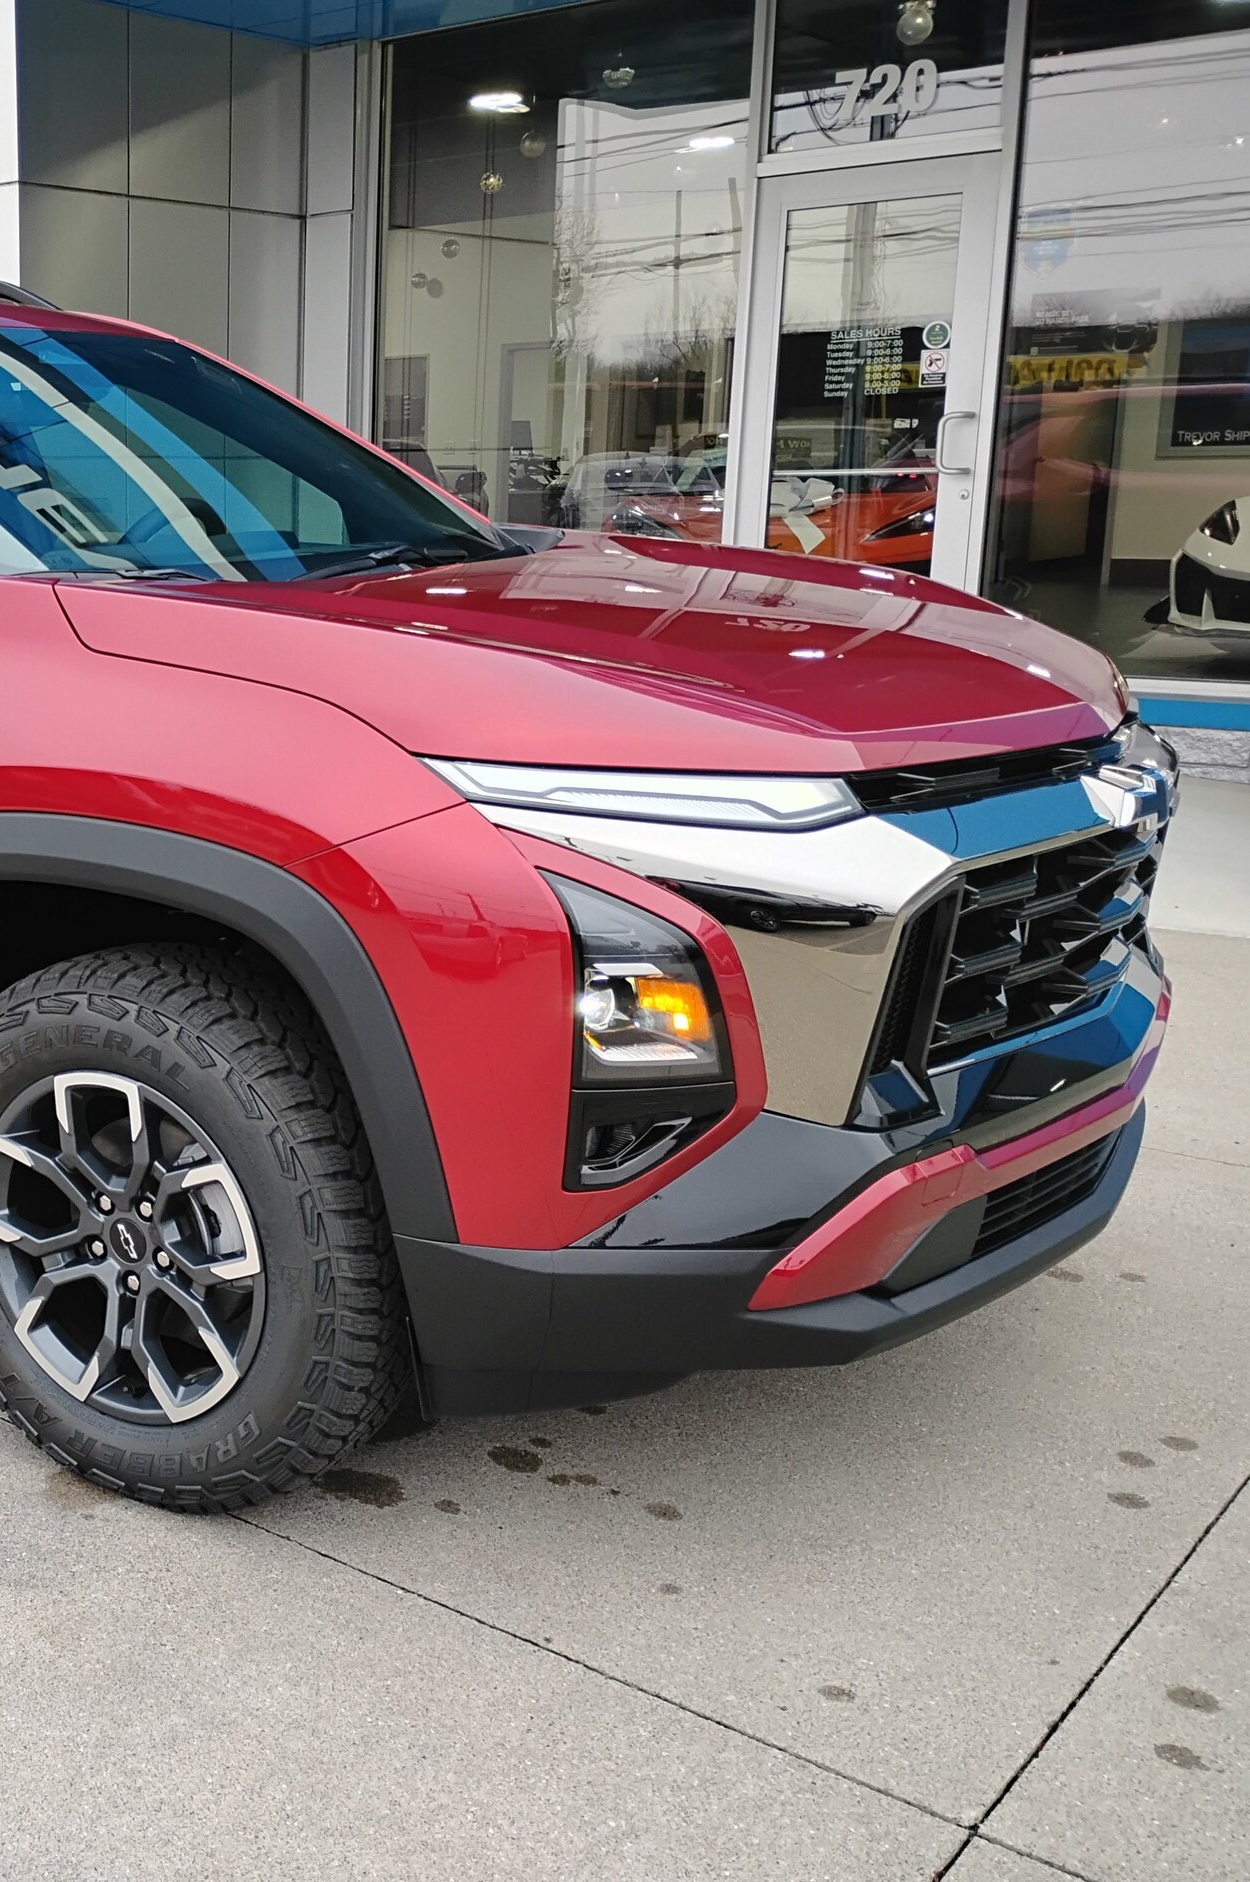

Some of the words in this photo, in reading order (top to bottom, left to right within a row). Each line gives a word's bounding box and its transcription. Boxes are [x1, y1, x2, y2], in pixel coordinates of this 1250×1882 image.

[834, 58, 939, 119] 720
[830, 329, 863, 340] SALES
[865, 327, 902, 338] HOURS
[827, 342, 854, 351] Monday
[867, 339, 904, 348] 9:00-7:00
[826, 350, 853, 359] Tuesday
[826, 357, 865, 367] Wednesday
[825, 366, 856, 375] Thursday
[824, 374, 845, 383] Friday
[824, 382, 853, 391] Saturday
[823, 390, 849, 398] Sunday
[863, 387, 899, 396] CLOSED
[1177, 430, 1221, 442] TREVOR
[66, 1412, 261, 1479] GRABBER
